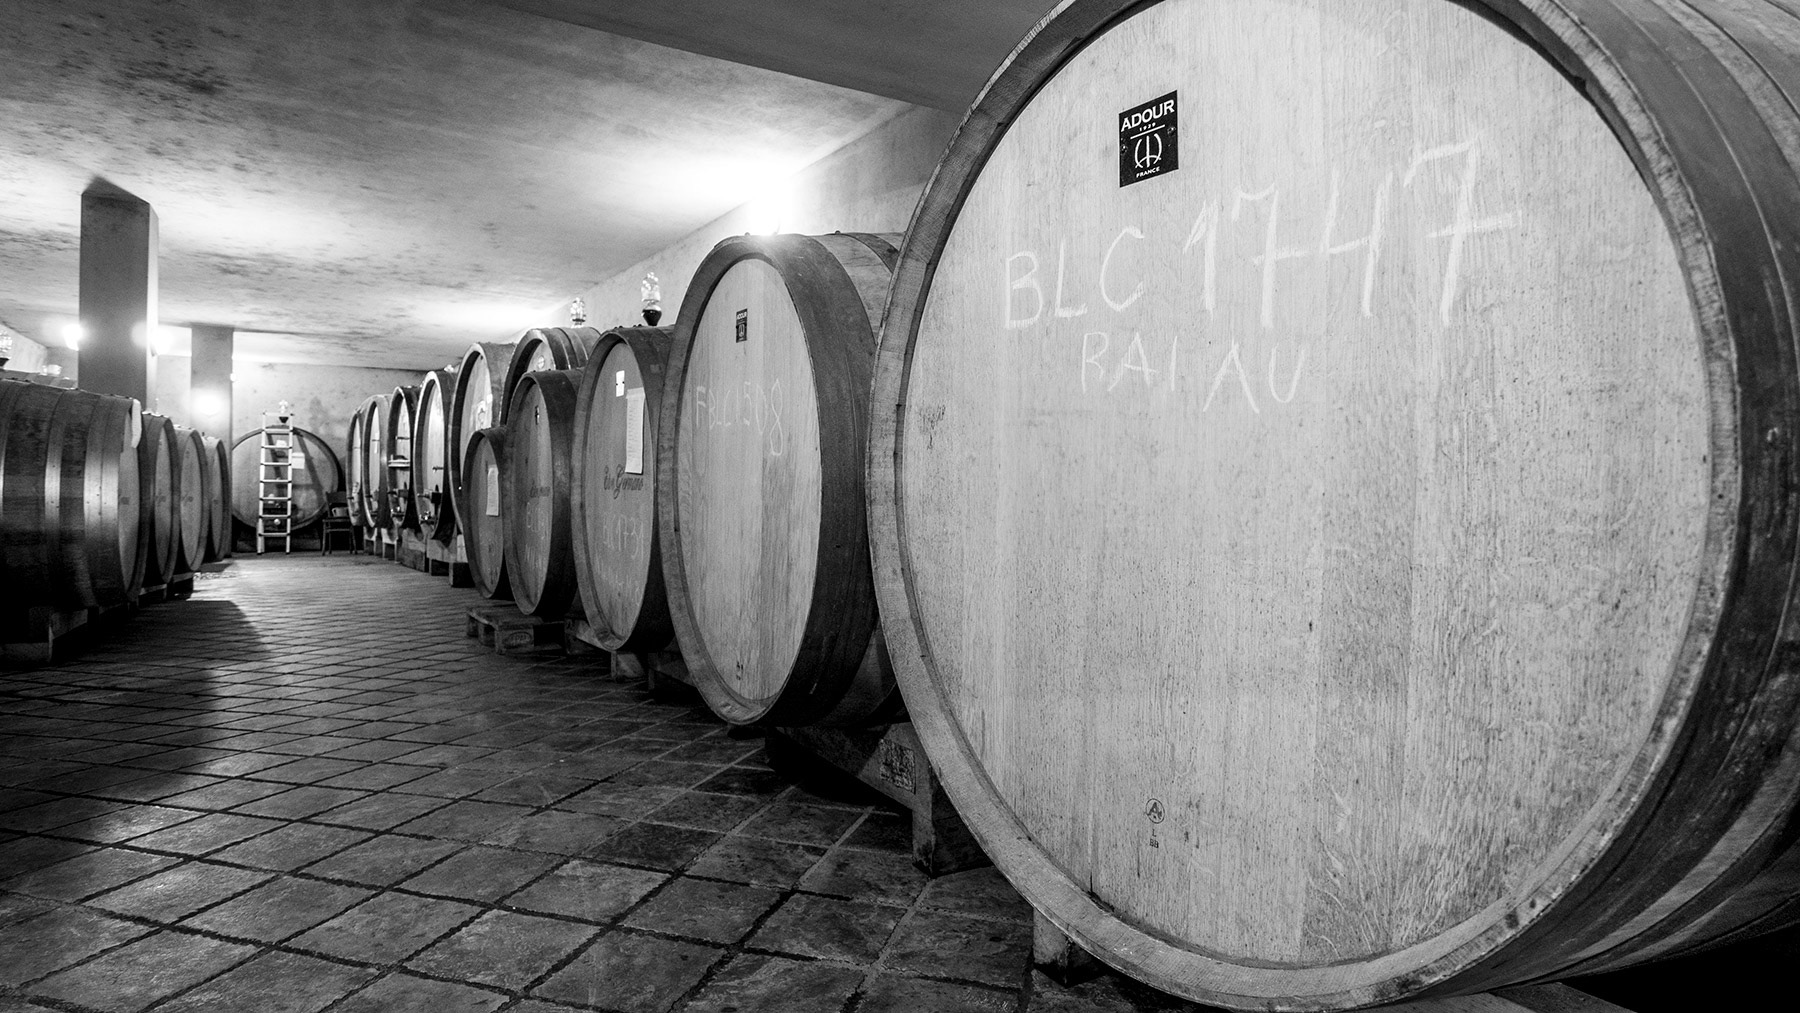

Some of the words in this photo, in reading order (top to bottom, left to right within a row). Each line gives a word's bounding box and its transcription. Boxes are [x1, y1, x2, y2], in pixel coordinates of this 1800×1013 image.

[1120, 99, 1175, 133] ADOUR
[1135, 166, 1161, 178] FRANCE
[1004, 225, 1145, 330] BLC
[1182, 138, 1522, 329] 1747
